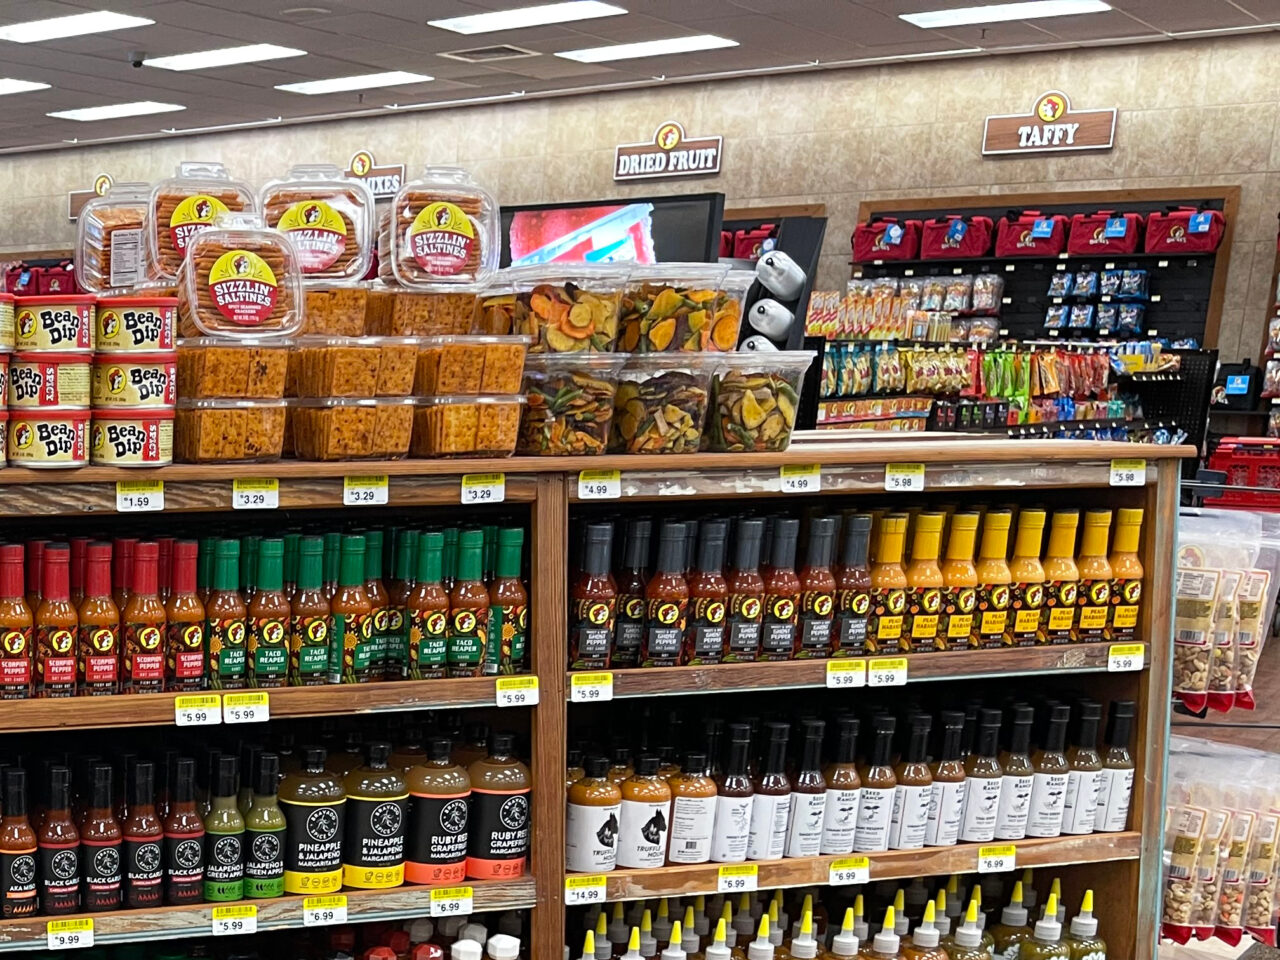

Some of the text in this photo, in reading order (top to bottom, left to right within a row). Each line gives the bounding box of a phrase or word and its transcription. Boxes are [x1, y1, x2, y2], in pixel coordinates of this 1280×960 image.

[1018, 122, 1080, 148] TAFFY
[619, 148, 717, 175] DRIED FRUIT
[414, 235, 470, 248] SIZZLIN'
[214, 281, 274, 297] SIZZLIN'
[40, 310, 80, 330] Bean
[49, 325, 77, 344] Dip
[264, 651, 282, 659] TACO
[362, 836, 404, 846] PINEAPPLE
[431, 834, 457, 845] RUBY
[298, 842, 341, 851] PINEAPPLE
[298, 851, 304, 860] &
[128, 872, 148, 880] BLACK
[246, 866, 283, 877] GREEN APPLE
